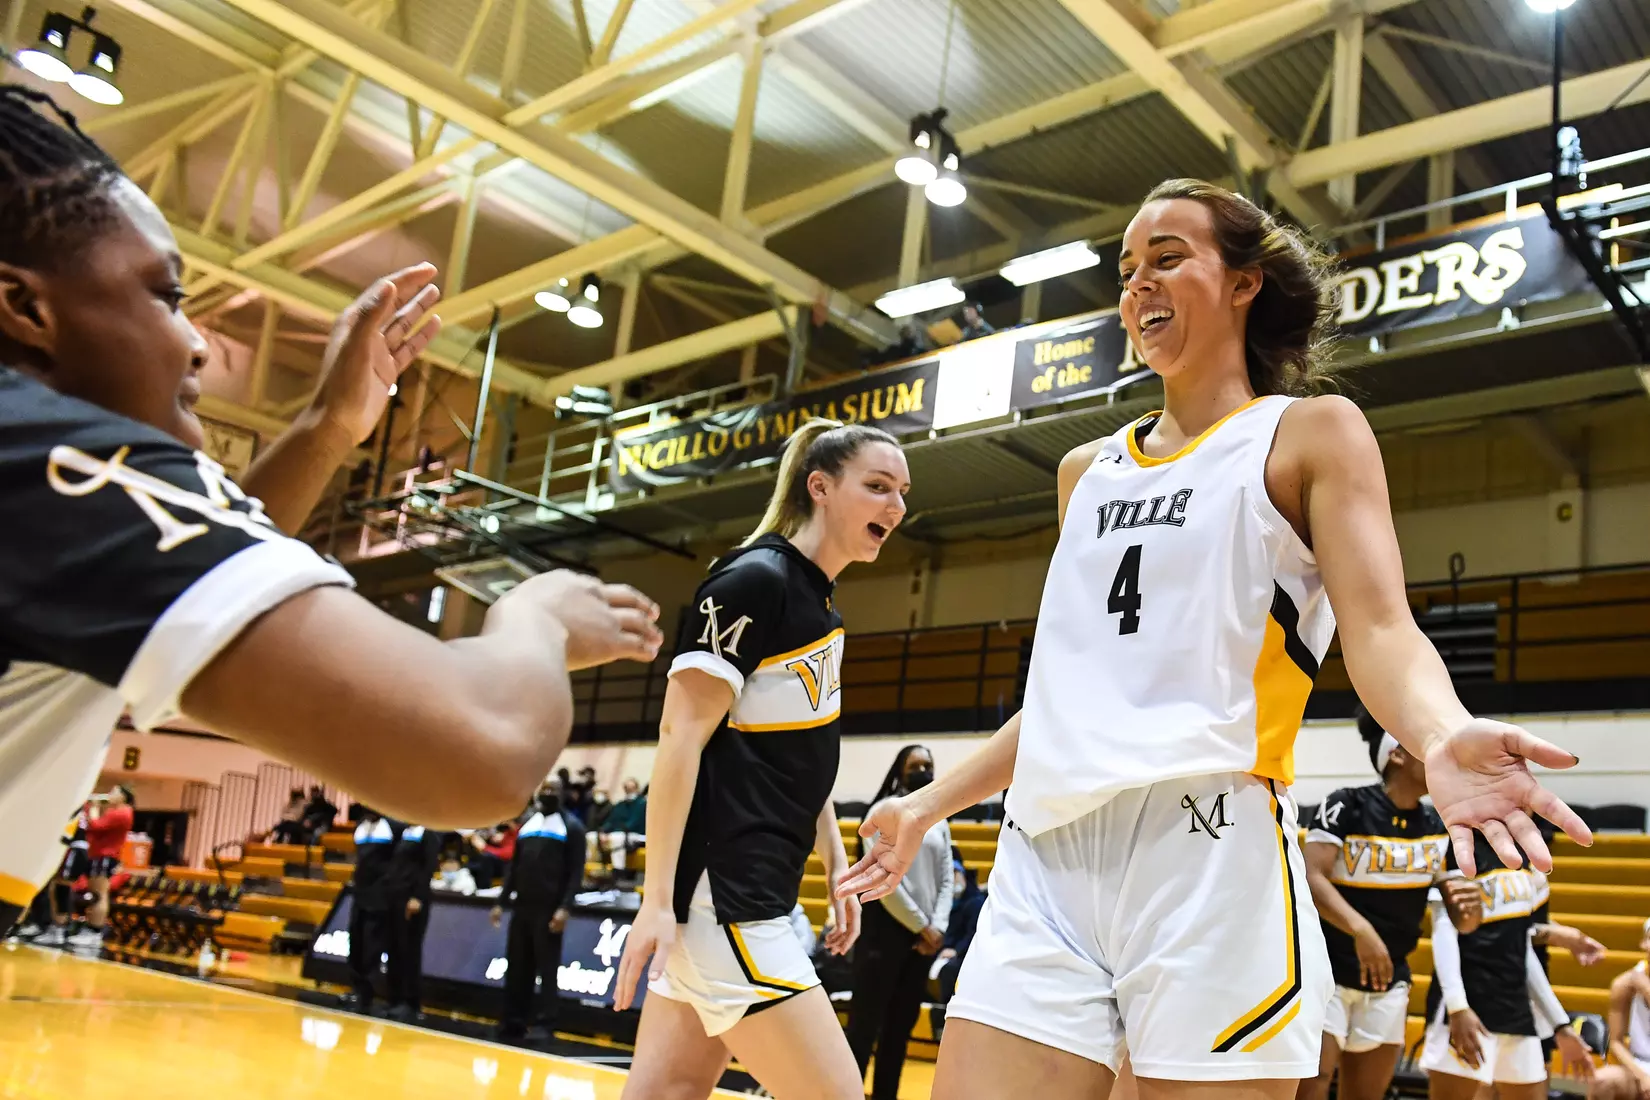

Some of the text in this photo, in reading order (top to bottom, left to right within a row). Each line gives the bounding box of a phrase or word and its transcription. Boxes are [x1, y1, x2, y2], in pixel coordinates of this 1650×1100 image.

[1034, 336, 1095, 365] Home
[1031, 362, 1092, 393] of the
[1096, 488, 1193, 538] VILLE
[1107, 544, 1143, 635] 4
[123, 746, 141, 771] B
[1343, 840, 1441, 876] VILLE
